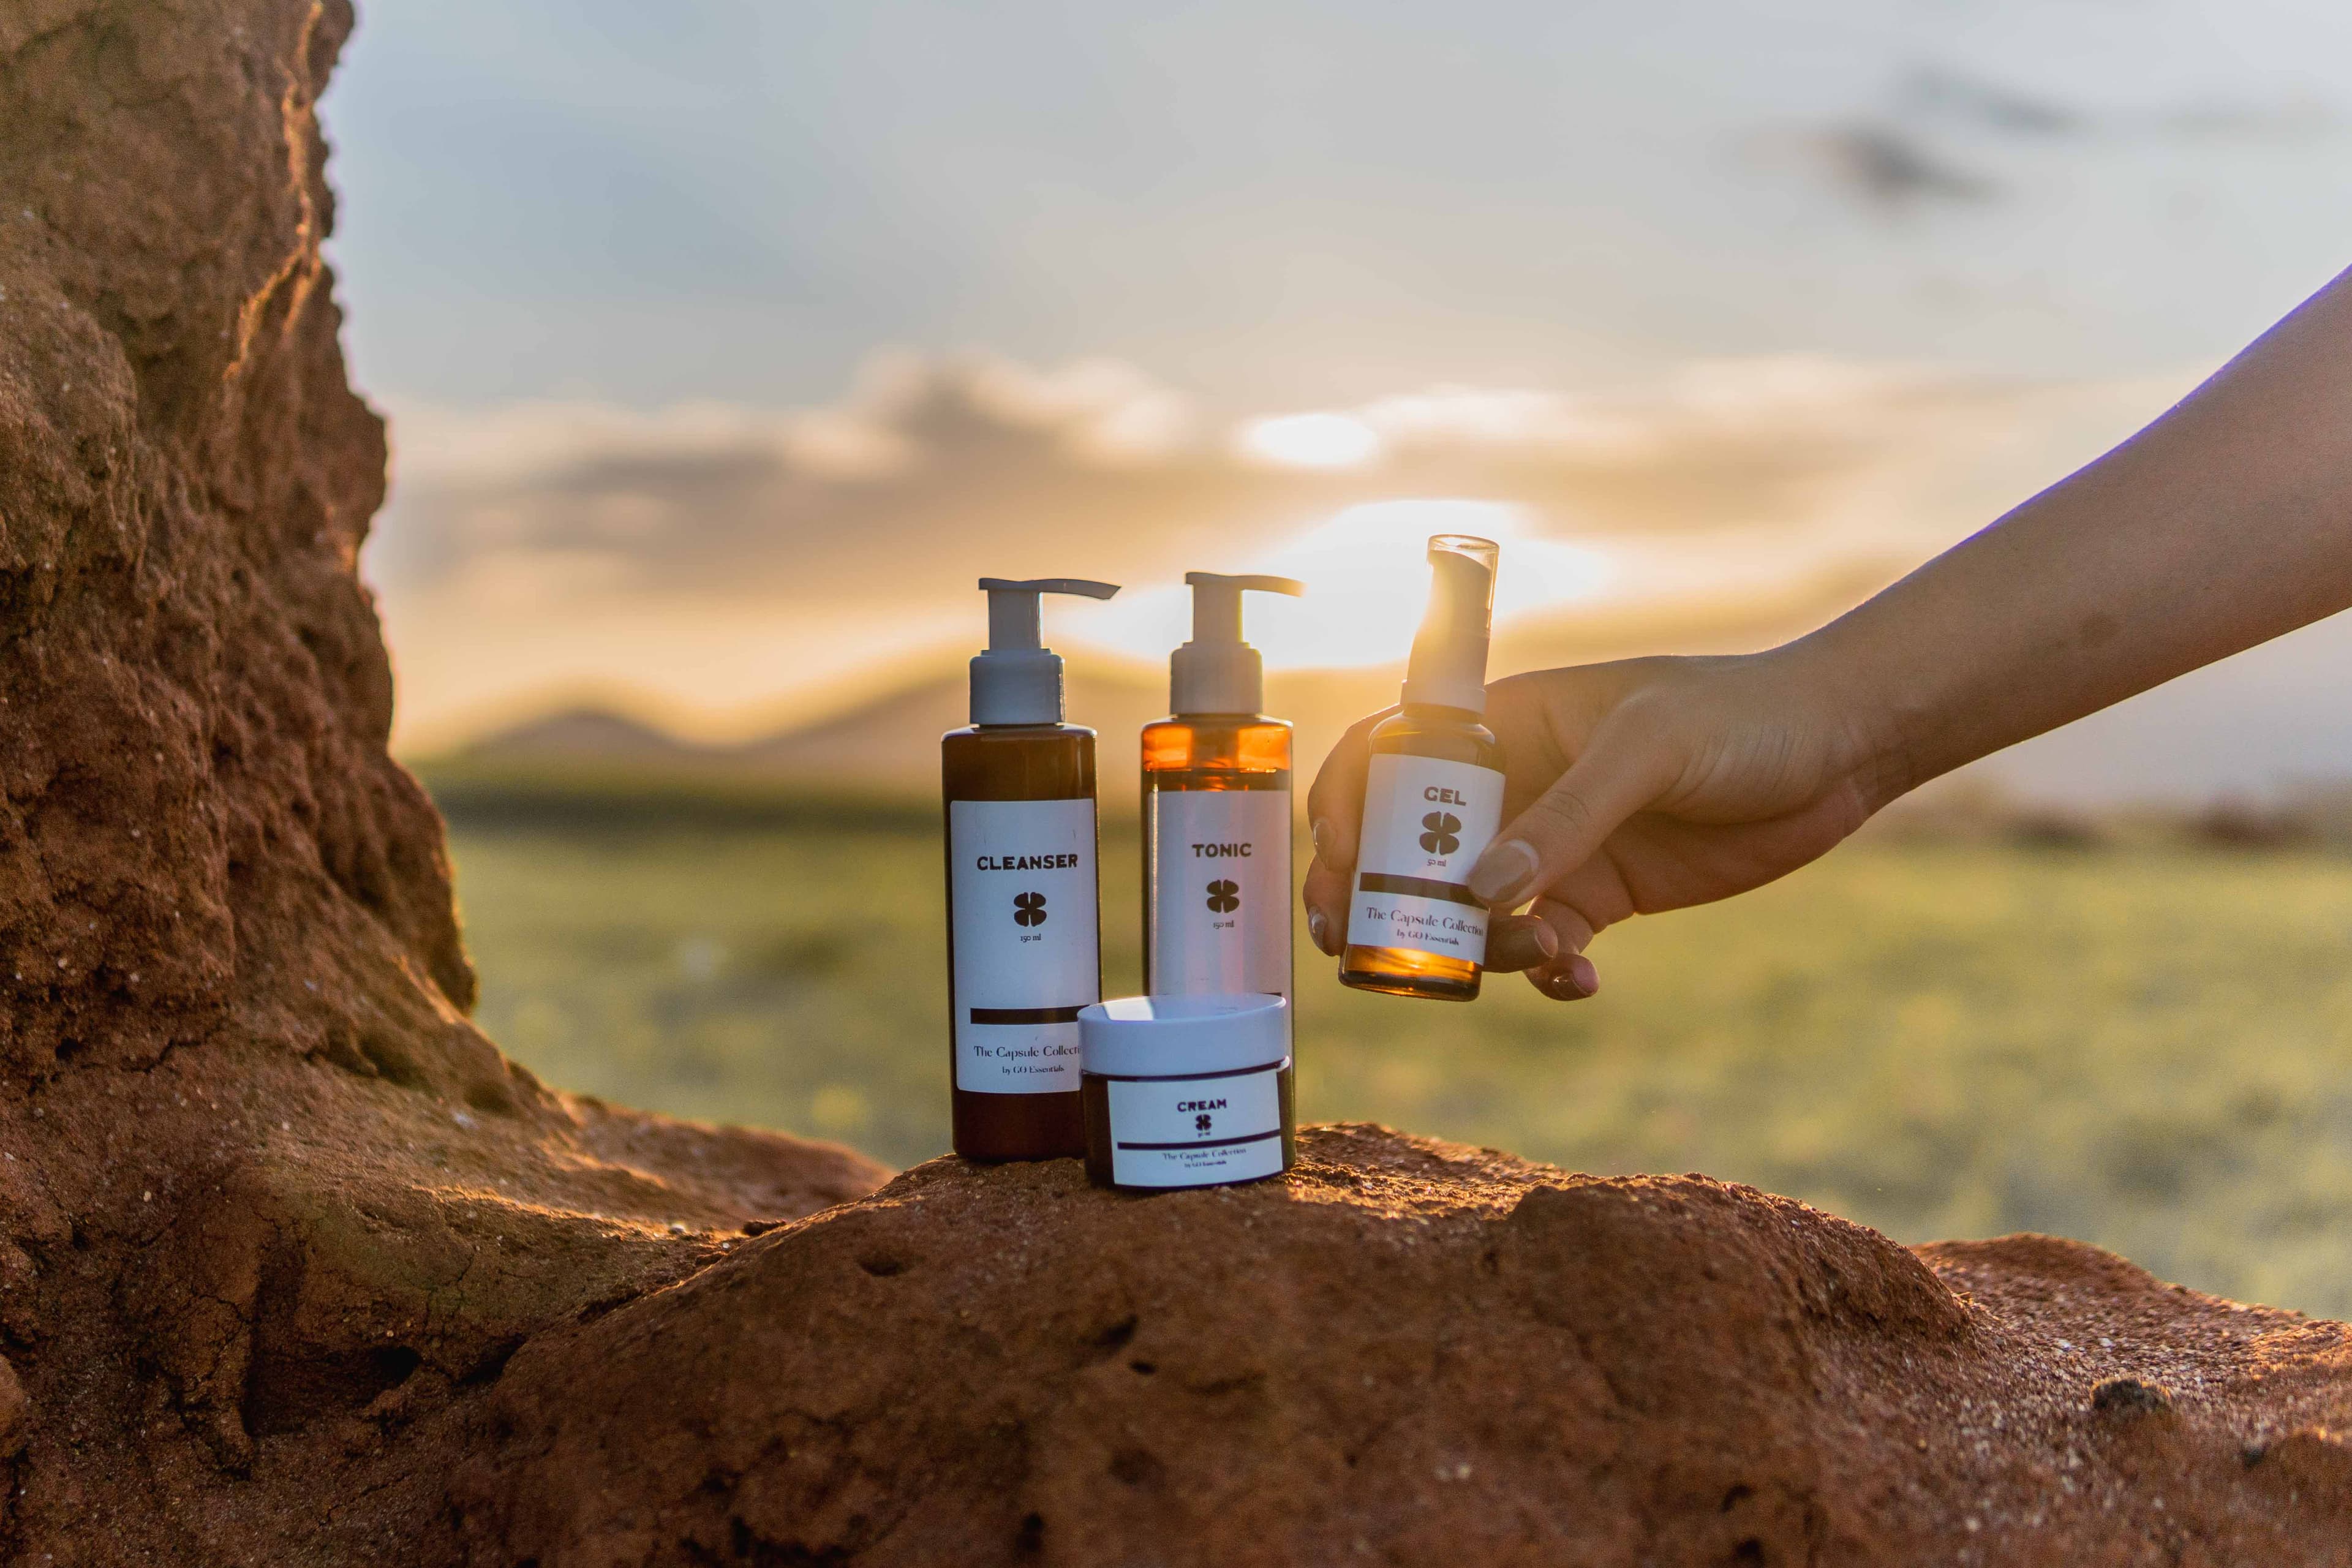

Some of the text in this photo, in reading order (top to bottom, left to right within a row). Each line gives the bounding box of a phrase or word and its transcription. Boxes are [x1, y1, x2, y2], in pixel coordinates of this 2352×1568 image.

[1424, 786, 1466, 806] GEL
[1192, 843, 1251, 858] TONIC
[977, 854, 1078, 871] CLEANSER
[1366, 907, 1484, 937] The Capsule Collection
[1397, 929, 1460, 946] by GO Essentials
[973, 1045, 1080, 1061] The Capsule Collecti
[1002, 1066, 1011, 1075] by
[1029, 1065, 1065, 1073] Essentials
[1177, 1099, 1227, 1112] CREAM
